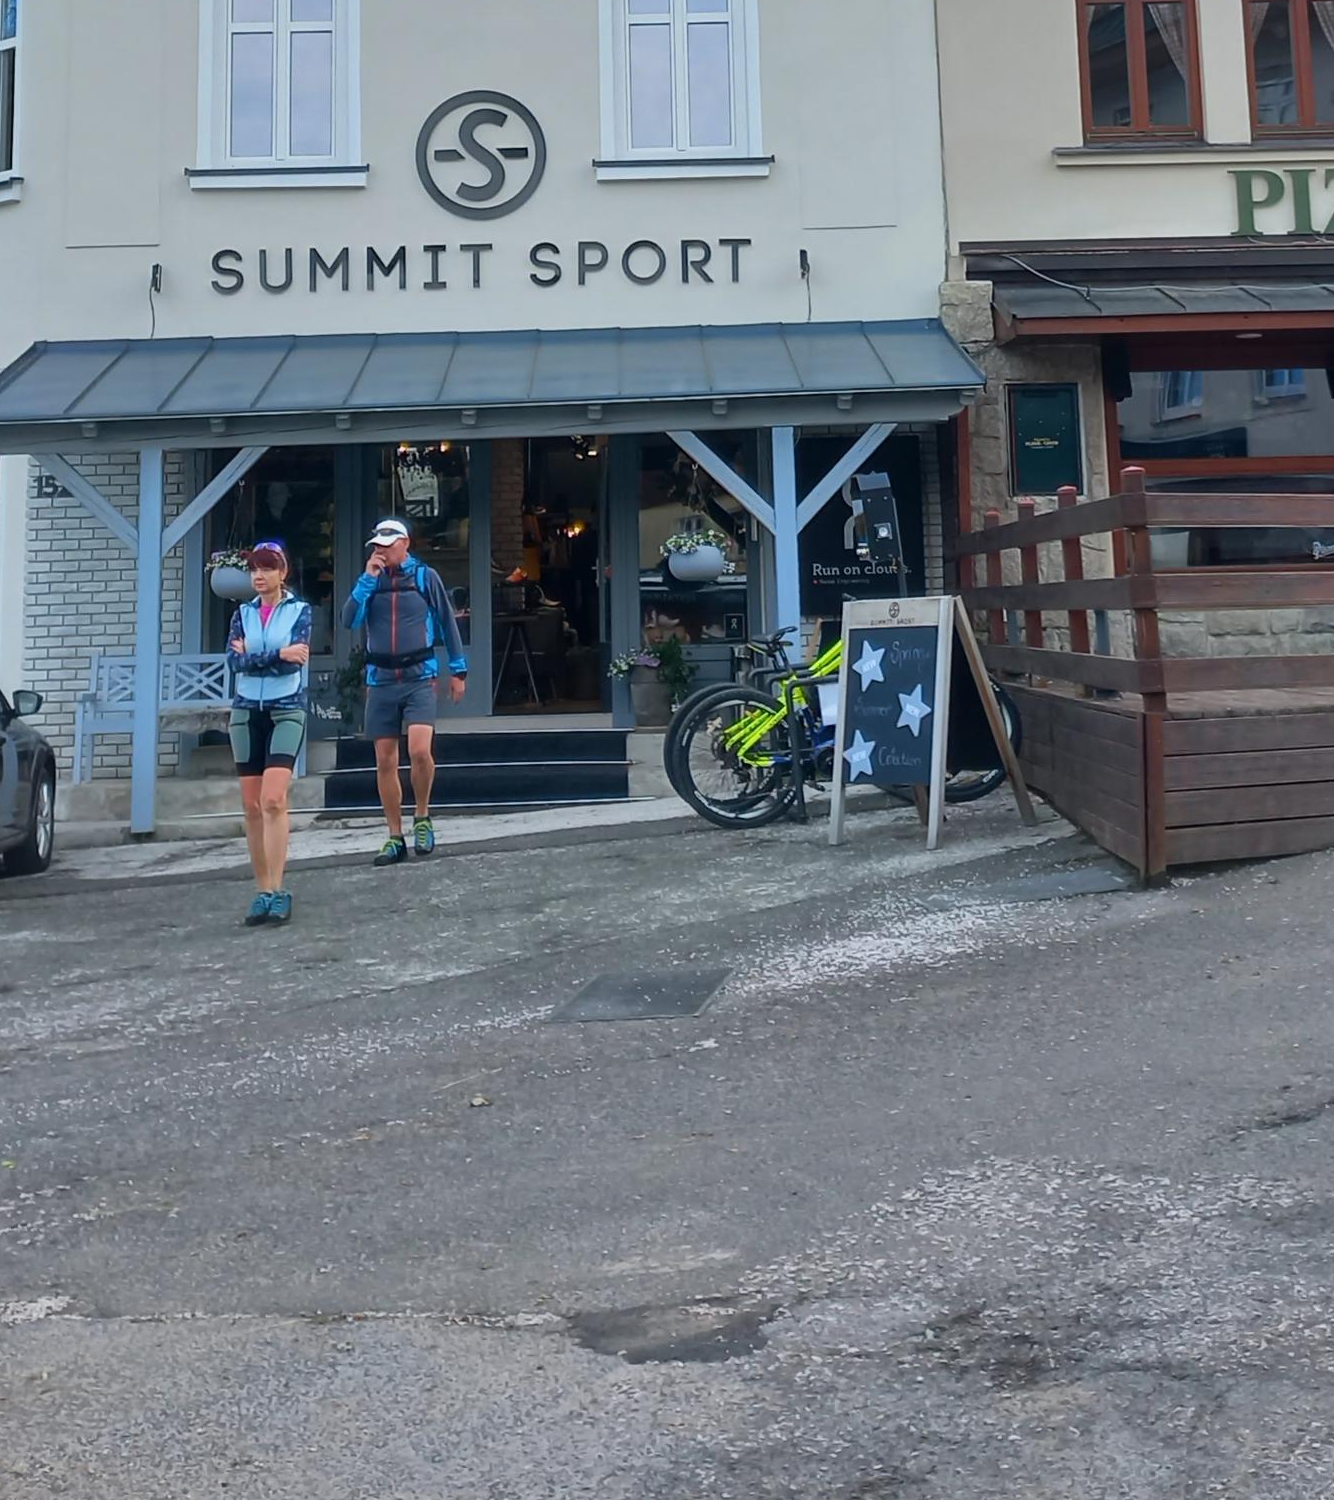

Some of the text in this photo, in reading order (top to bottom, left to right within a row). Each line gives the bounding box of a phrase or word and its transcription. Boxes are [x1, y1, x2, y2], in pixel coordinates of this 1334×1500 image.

[210, 237, 753, 296] SUMMIT SPORT
[812, 563, 840, 576] Run
[843, 566, 861, 575] on
